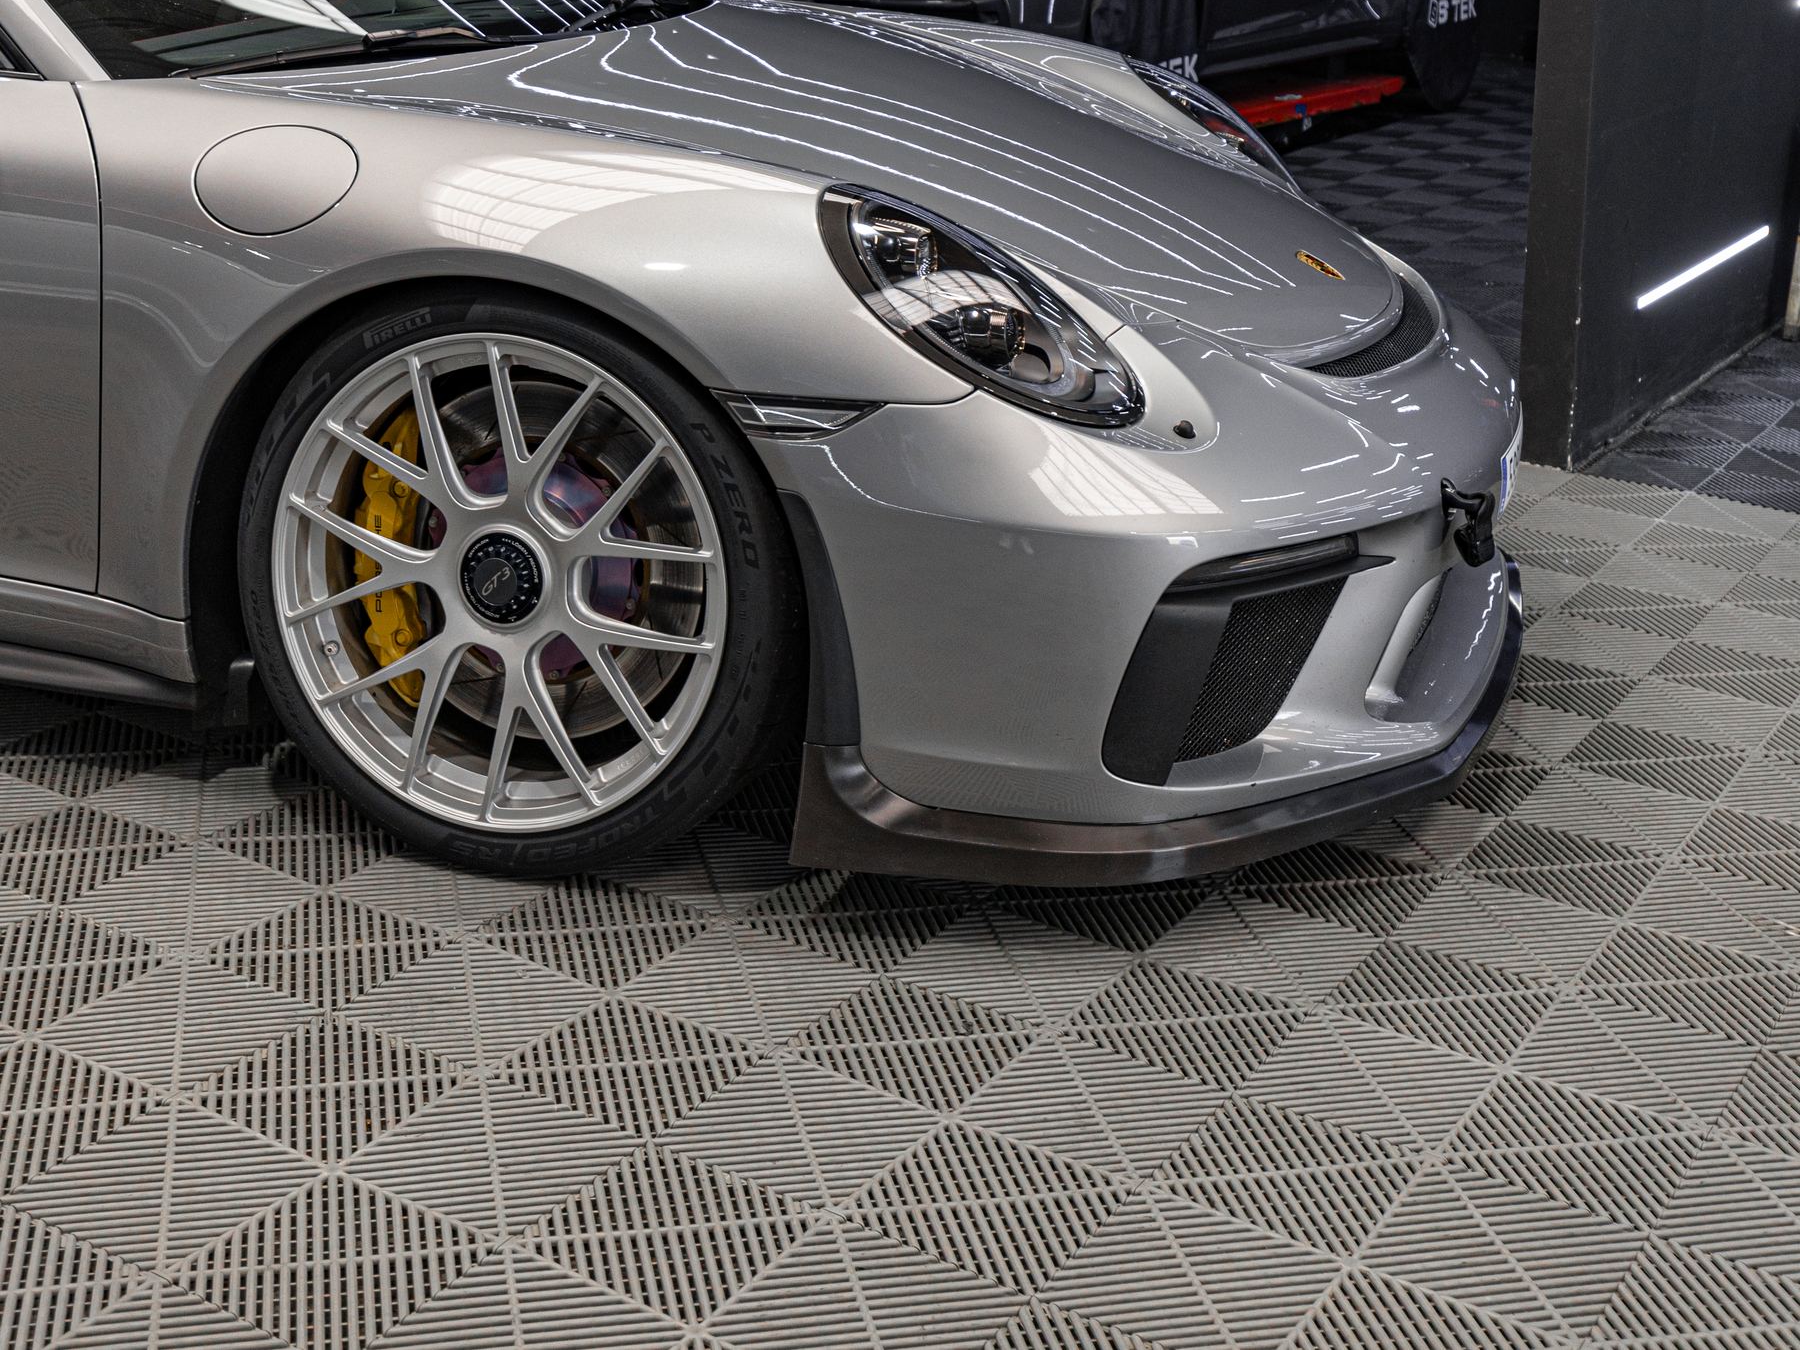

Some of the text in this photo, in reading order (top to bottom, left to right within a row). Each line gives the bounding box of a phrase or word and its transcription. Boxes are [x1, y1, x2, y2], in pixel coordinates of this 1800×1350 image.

[362, 306, 432, 350] PIRELLI
[689, 422, 760, 570] P ZERO
